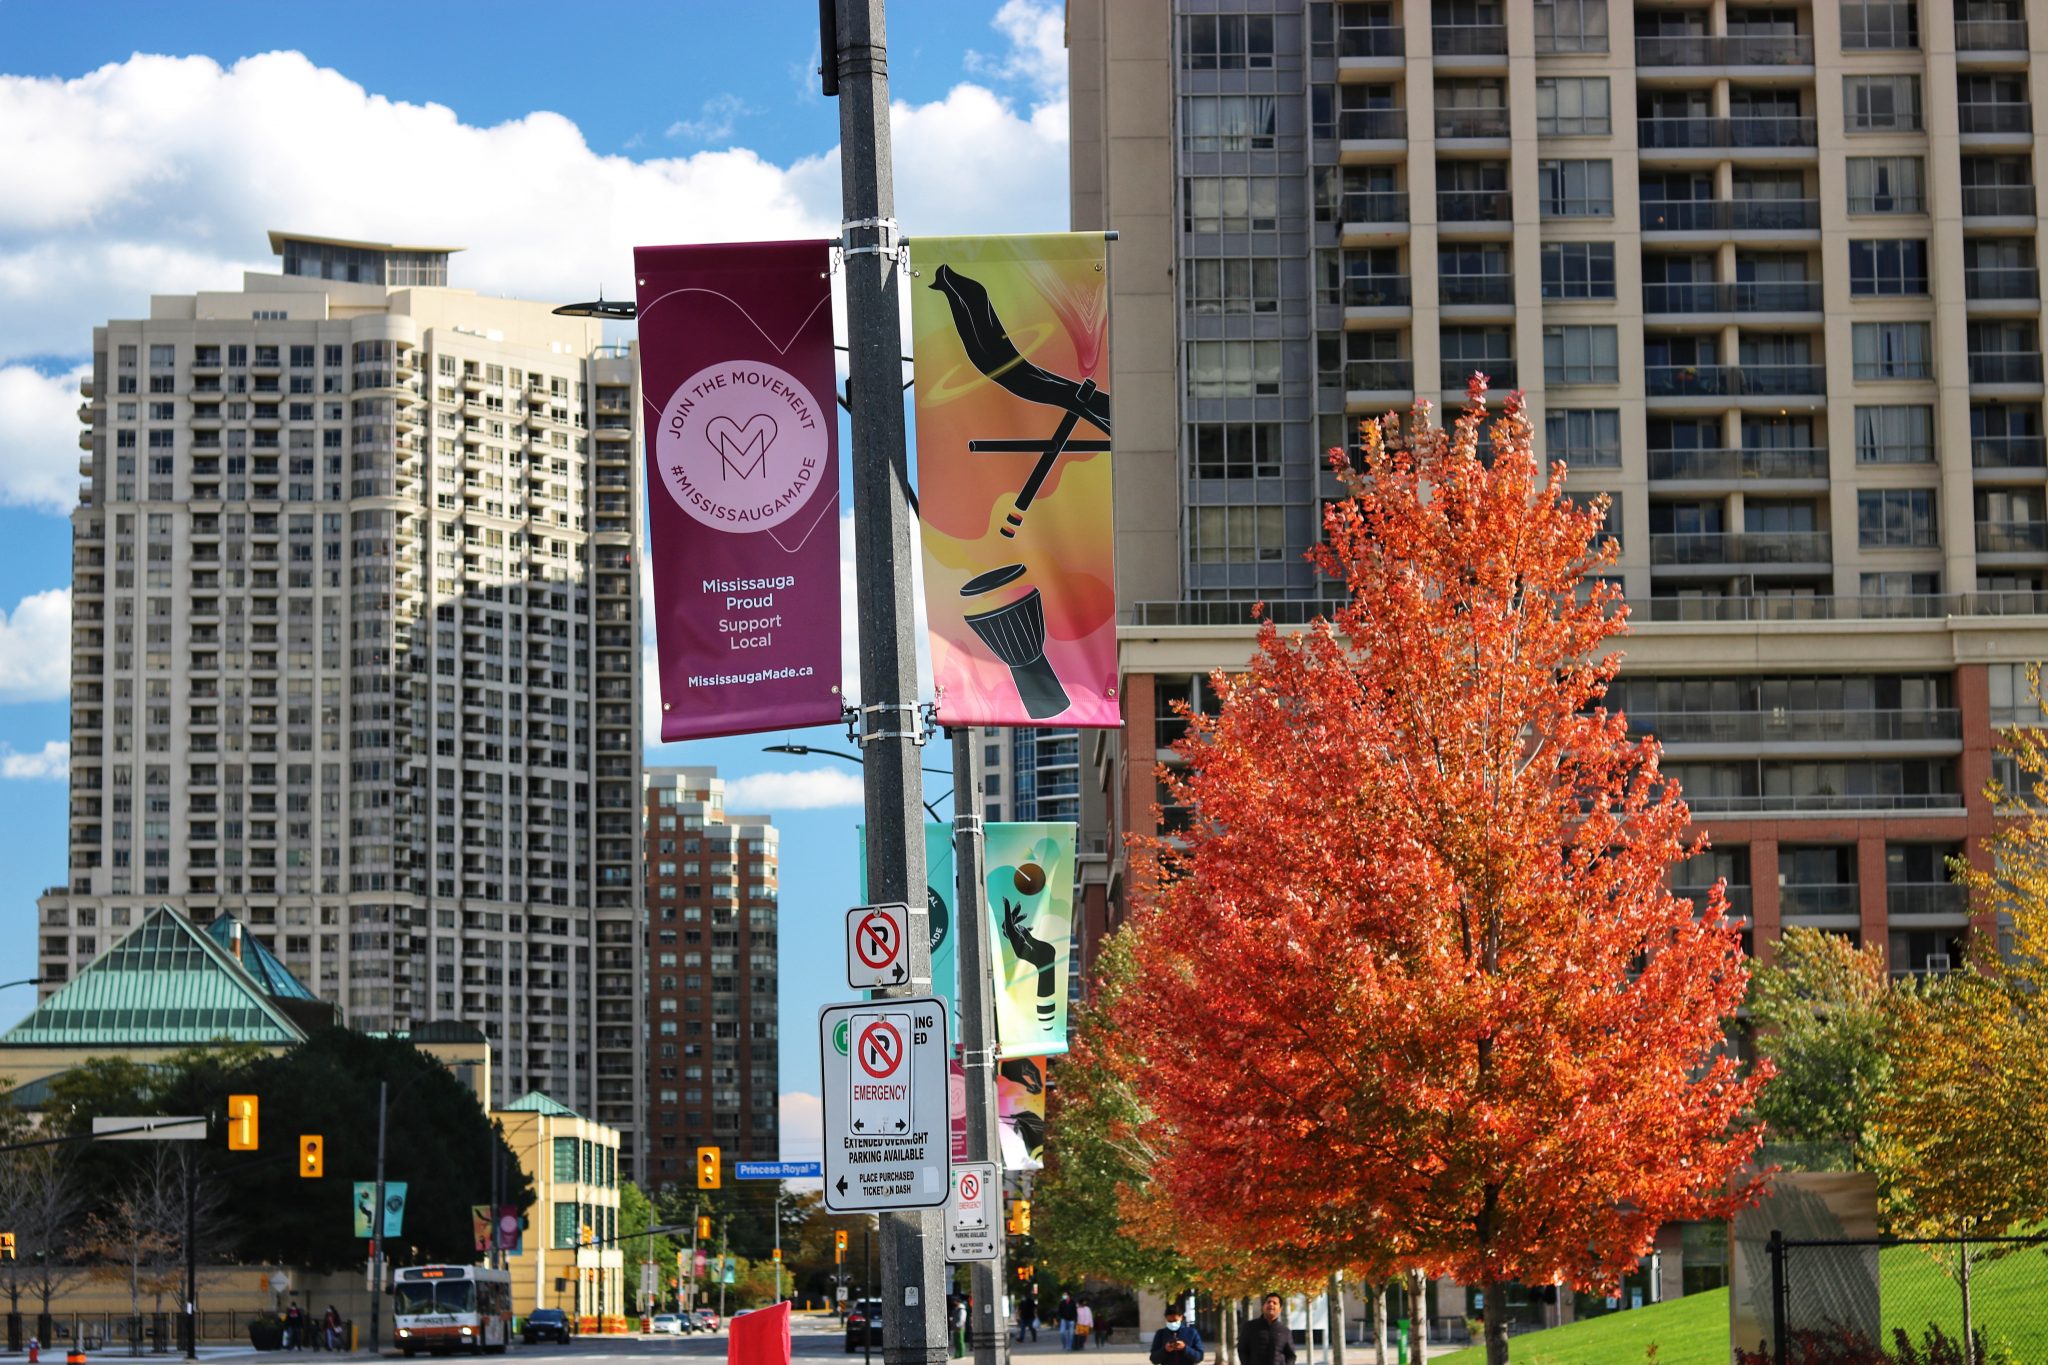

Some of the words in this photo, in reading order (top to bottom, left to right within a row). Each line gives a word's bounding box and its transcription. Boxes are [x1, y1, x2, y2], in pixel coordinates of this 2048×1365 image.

[669, 398, 695, 439] JOIN
[692, 374, 727, 398] THE
[732, 372, 815, 430] MOVEMENT
[671, 457, 816, 522] #MISSISSAUGAMADE
[702, 575, 795, 593] Mississauga
[726, 593, 773, 610] Proud
[719, 614, 781, 633] Support
[730, 632, 772, 650] Local
[688, 666, 813, 688] MississaugaMade.ca
[854, 1085, 907, 1101] EMERGENCY
[848, 1150, 882, 1164] PARKING
[883, 1148, 924, 1162] AVAILABLE
[740, 1165, 780, 1175] Princess
[782, 1164, 809, 1175] Royal
[859, 1172, 878, 1183] PLACE
[879, 1171, 915, 1182] PURCHASED
[863, 1186, 883, 1196] TICKET
[895, 1184, 911, 1194] DASH
